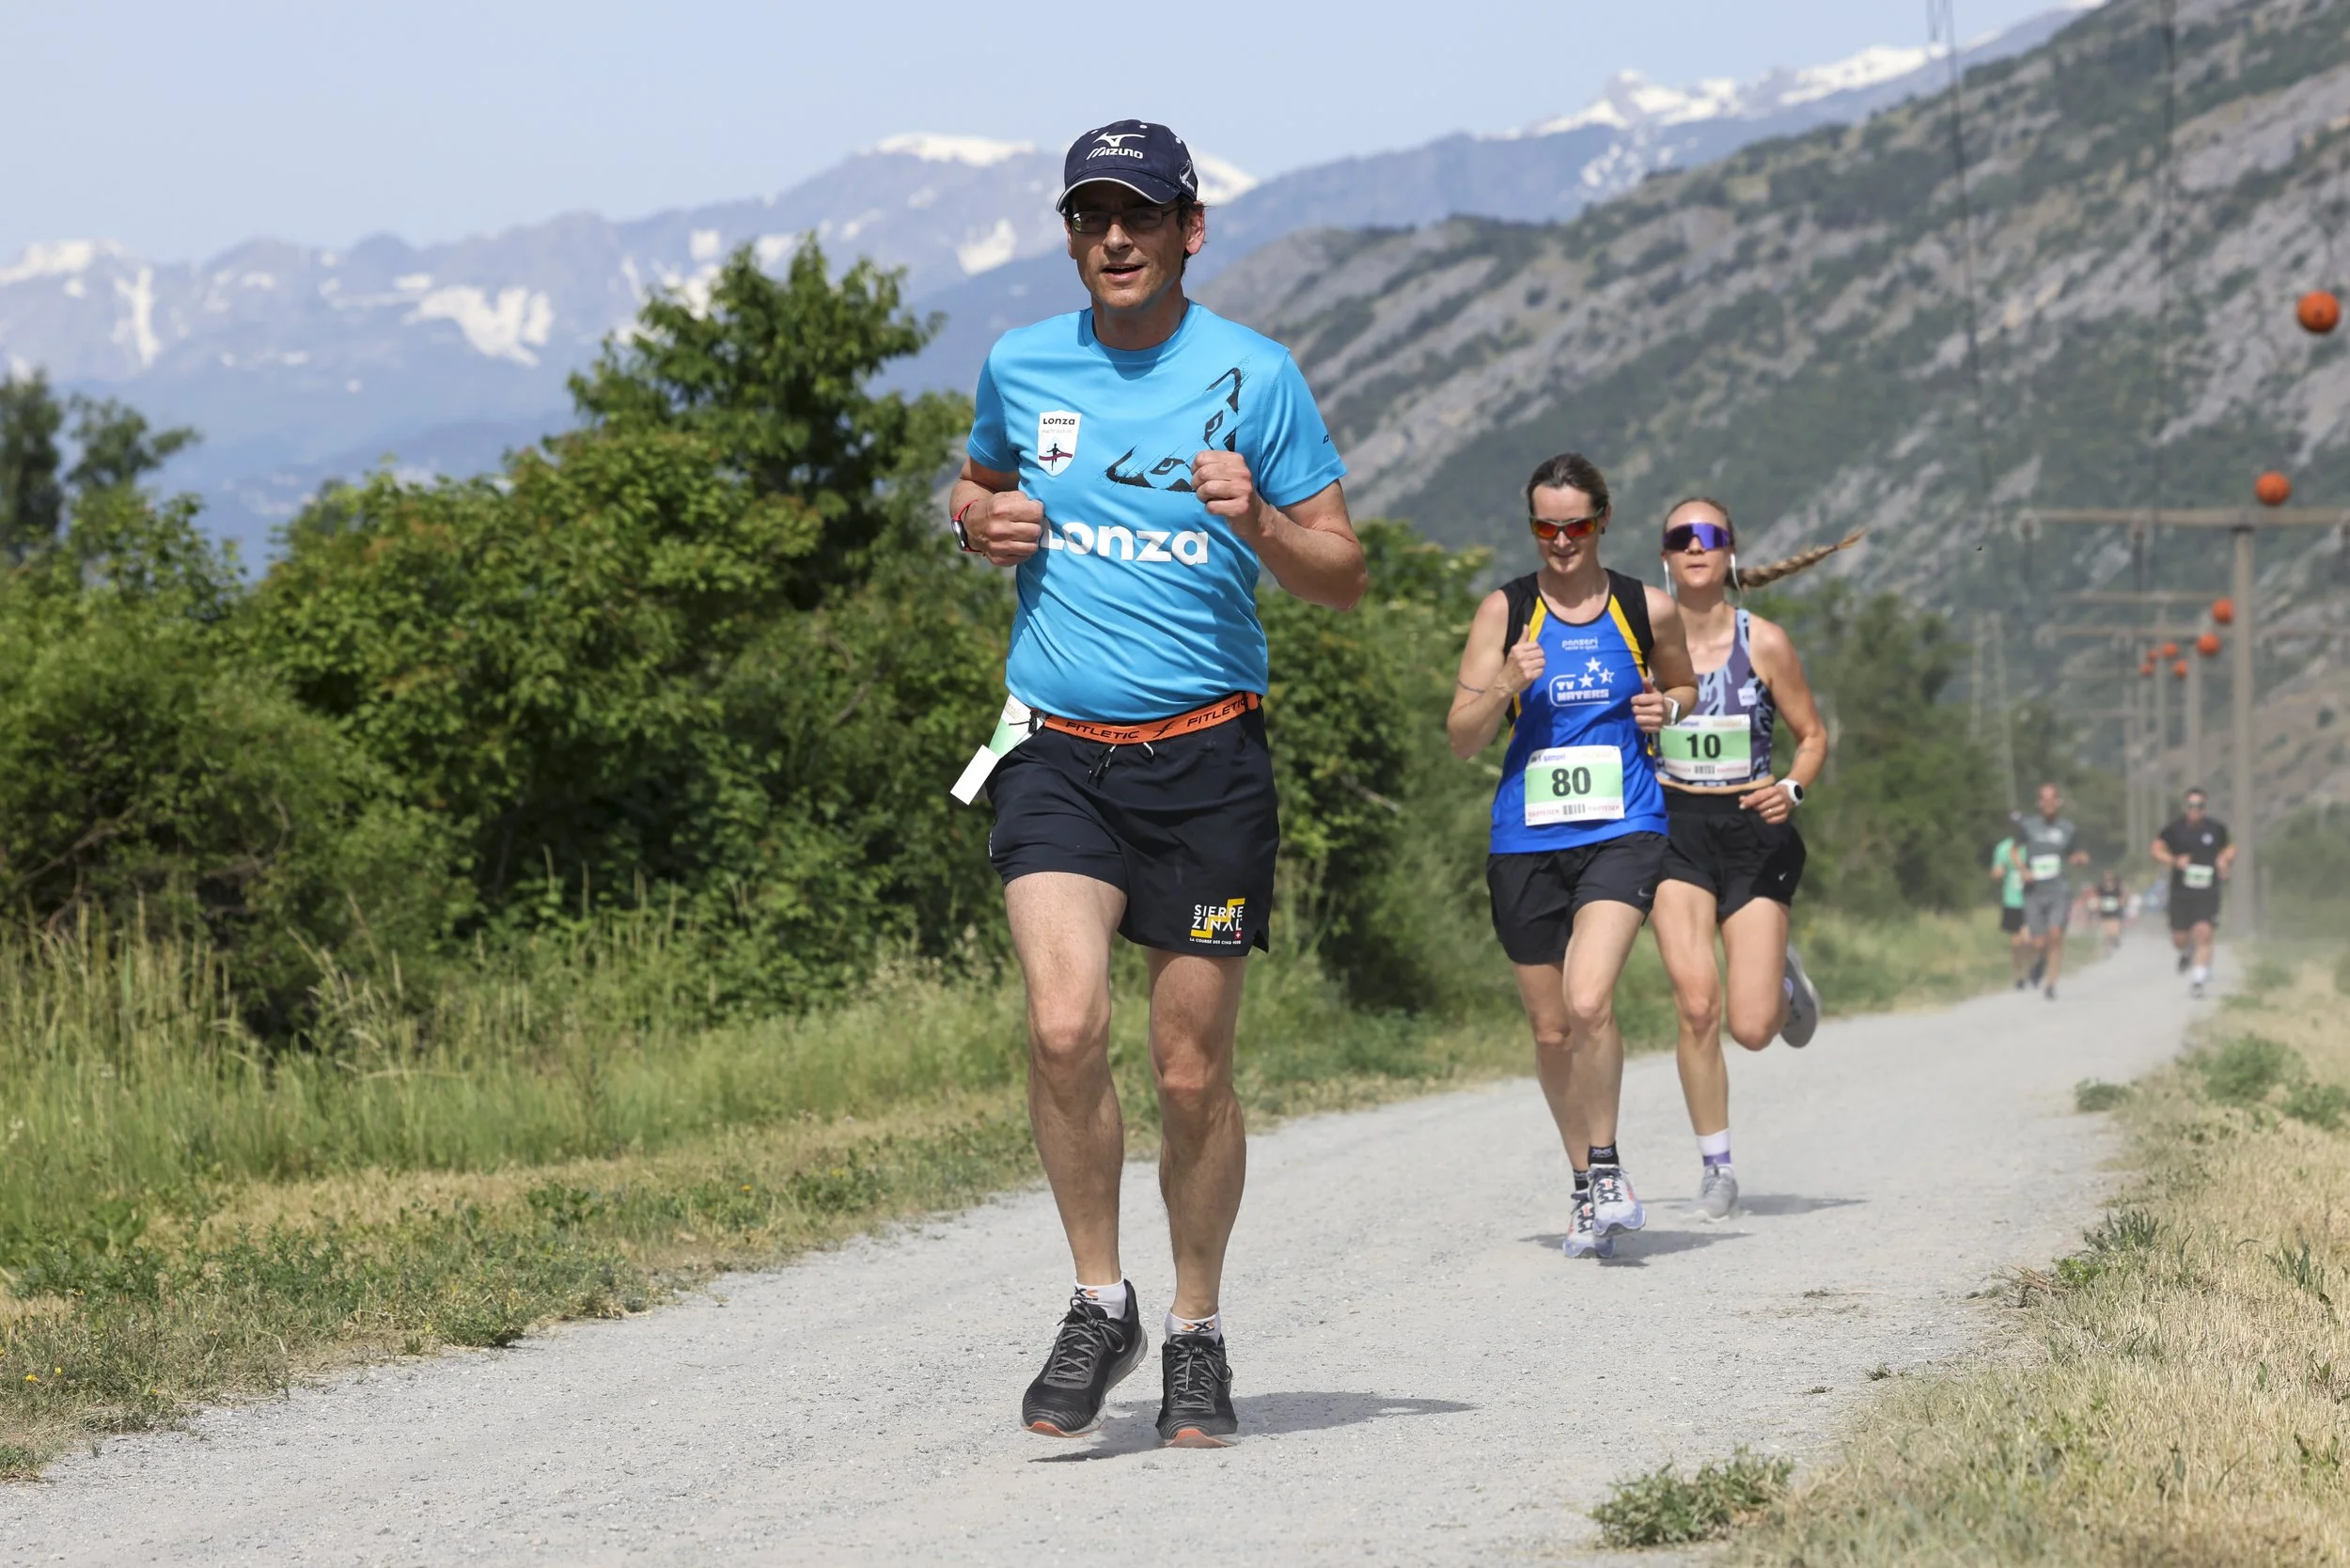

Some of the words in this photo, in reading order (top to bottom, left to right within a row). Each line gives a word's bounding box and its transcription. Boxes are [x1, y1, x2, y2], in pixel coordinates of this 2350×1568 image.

[1086, 147, 1143, 160] MIZUNO
[1040, 518, 1208, 566] Lonza
[1556, 681, 1574, 691] TV
[1186, 698, 1247, 728] FITLETIC
[1065, 721, 1139, 740] FITLETIC
[1686, 733, 1721, 759] 10
[1552, 766, 1591, 797] 80
[1194, 904, 1244, 917] SIERRE
[1192, 916, 1243, 932] ZINAL
